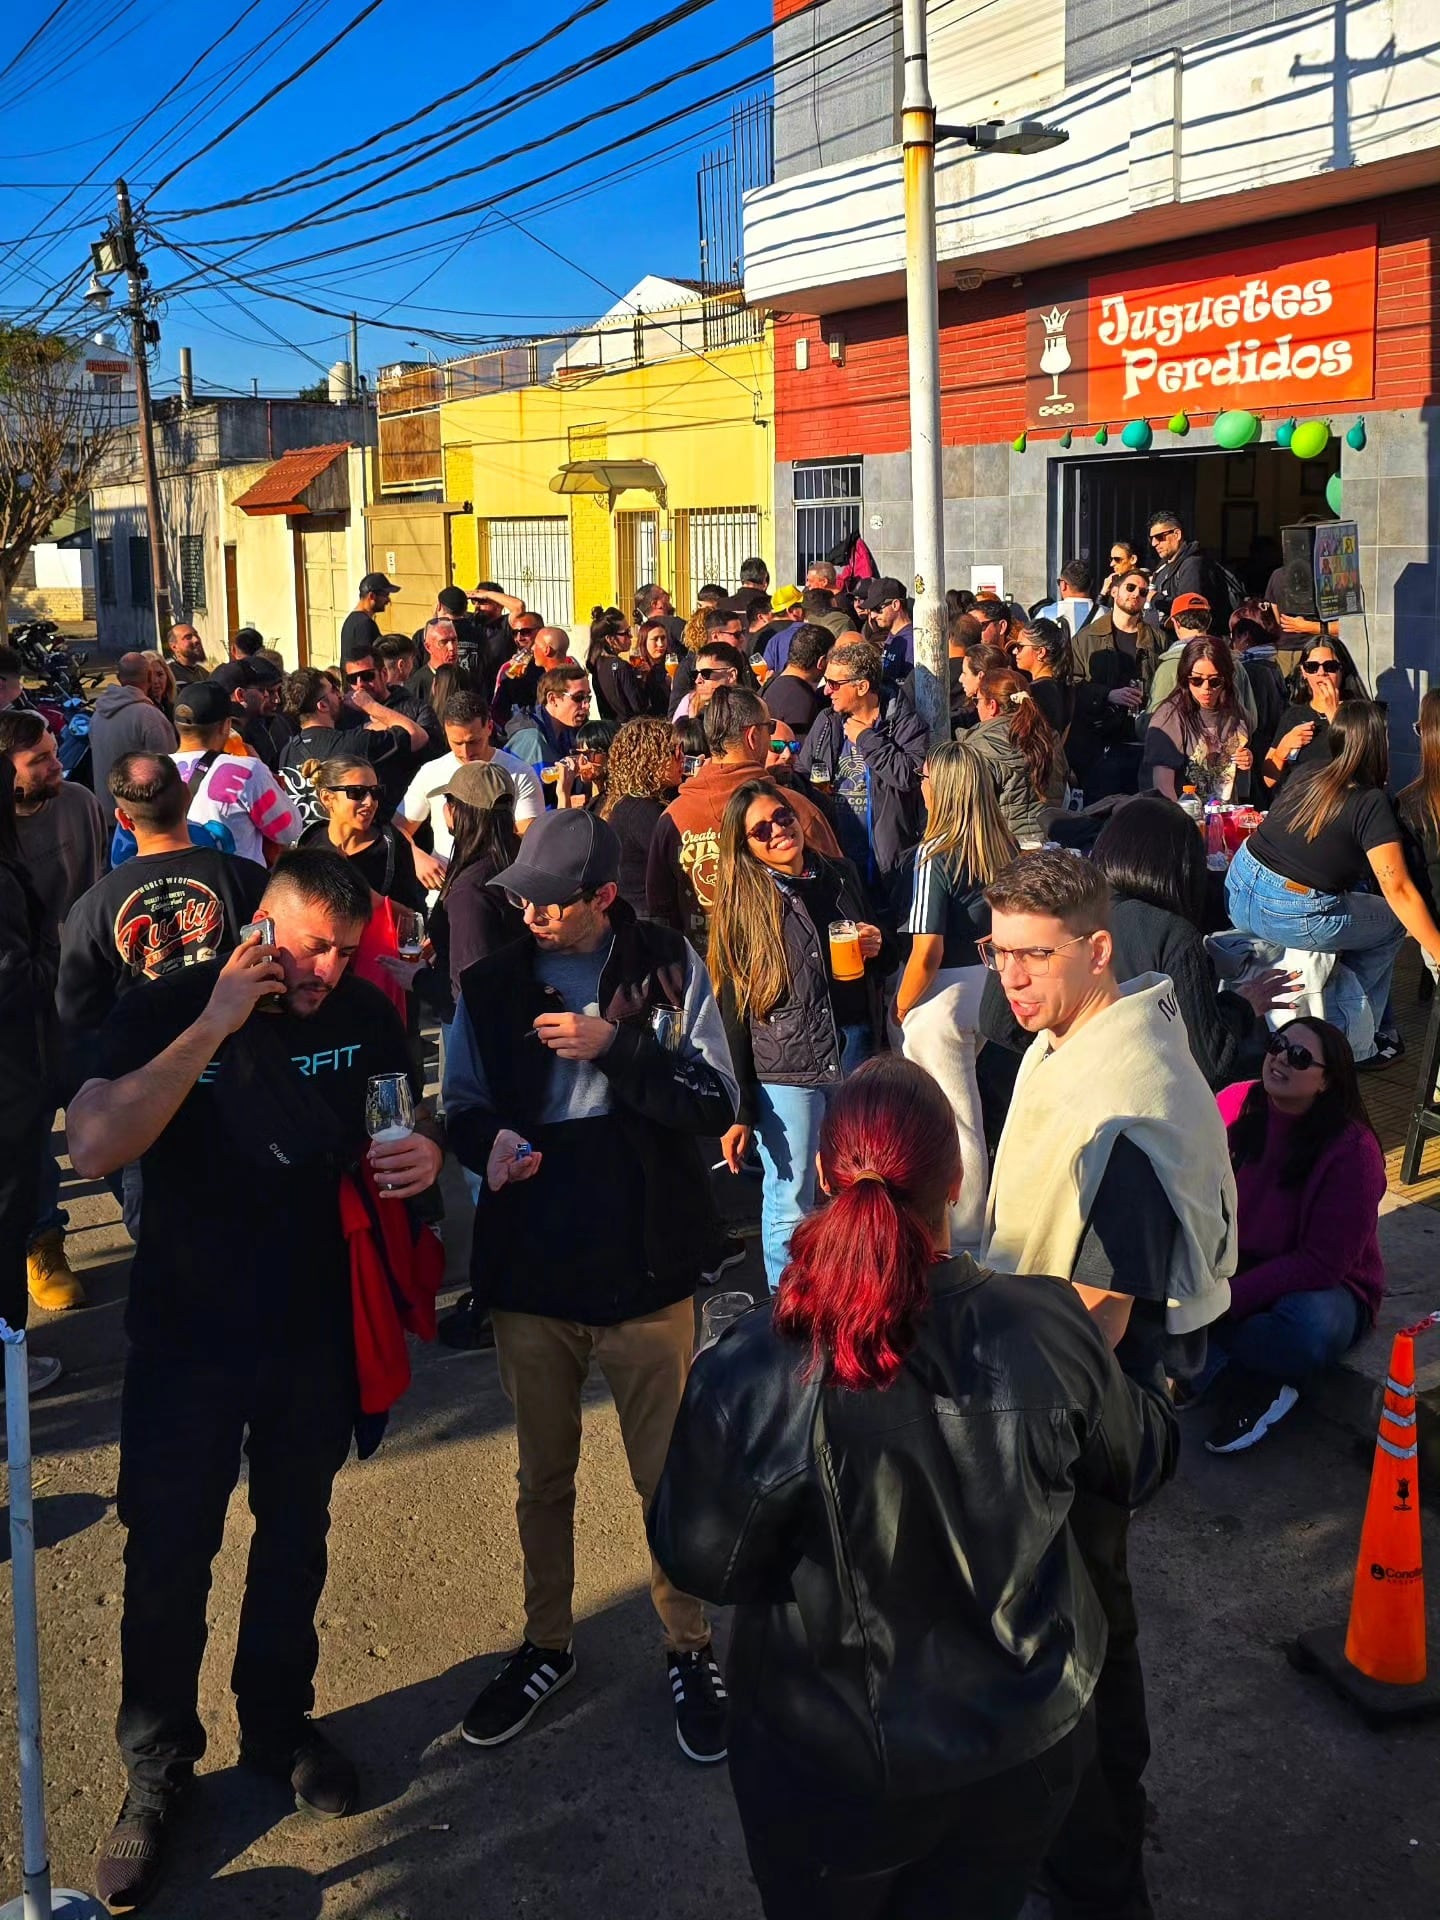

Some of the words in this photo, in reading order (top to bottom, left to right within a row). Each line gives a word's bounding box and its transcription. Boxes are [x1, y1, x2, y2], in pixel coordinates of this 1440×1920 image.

[1098, 279, 1333, 346] Juguetes
[1121, 333, 1353, 400] Perdidos
[681, 827, 717, 845] Create
[118, 898, 217, 967] Rusty
